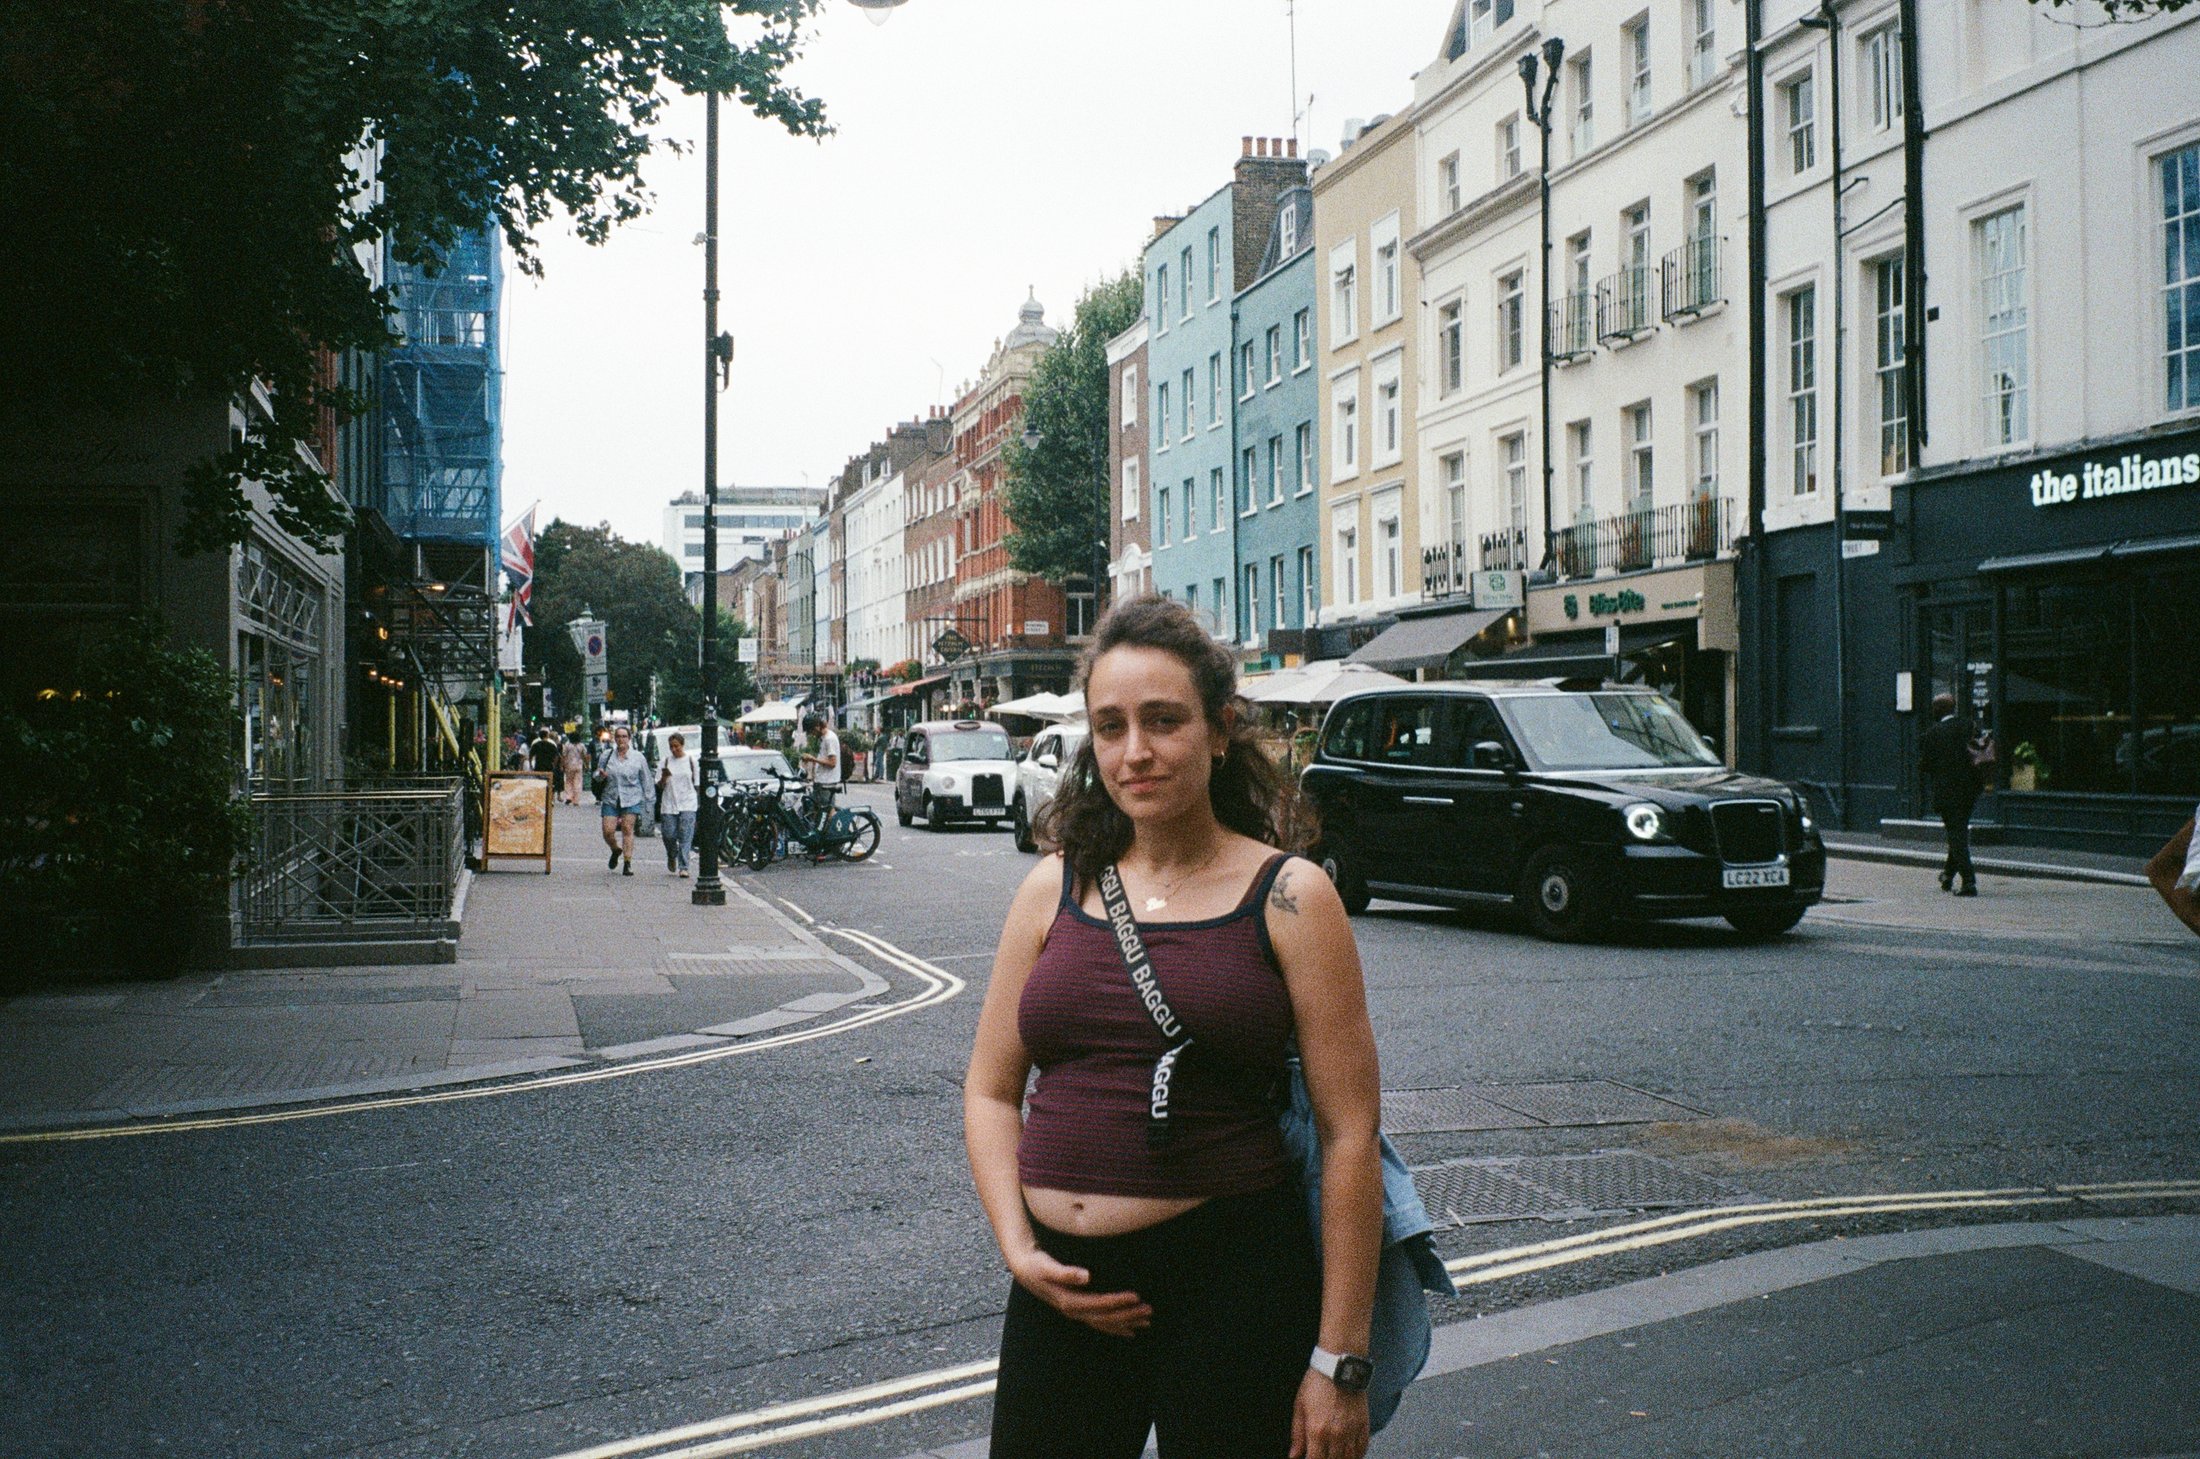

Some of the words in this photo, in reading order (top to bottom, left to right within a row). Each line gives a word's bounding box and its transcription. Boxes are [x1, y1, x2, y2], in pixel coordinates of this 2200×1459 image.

[2031, 469, 2078, 507] the
[2082, 453, 2200, 499] italians
[1100, 864, 1122, 901] GGU
[1108, 900, 1144, 964] BAGGU
[1131, 963, 1182, 1038] BAGGU
